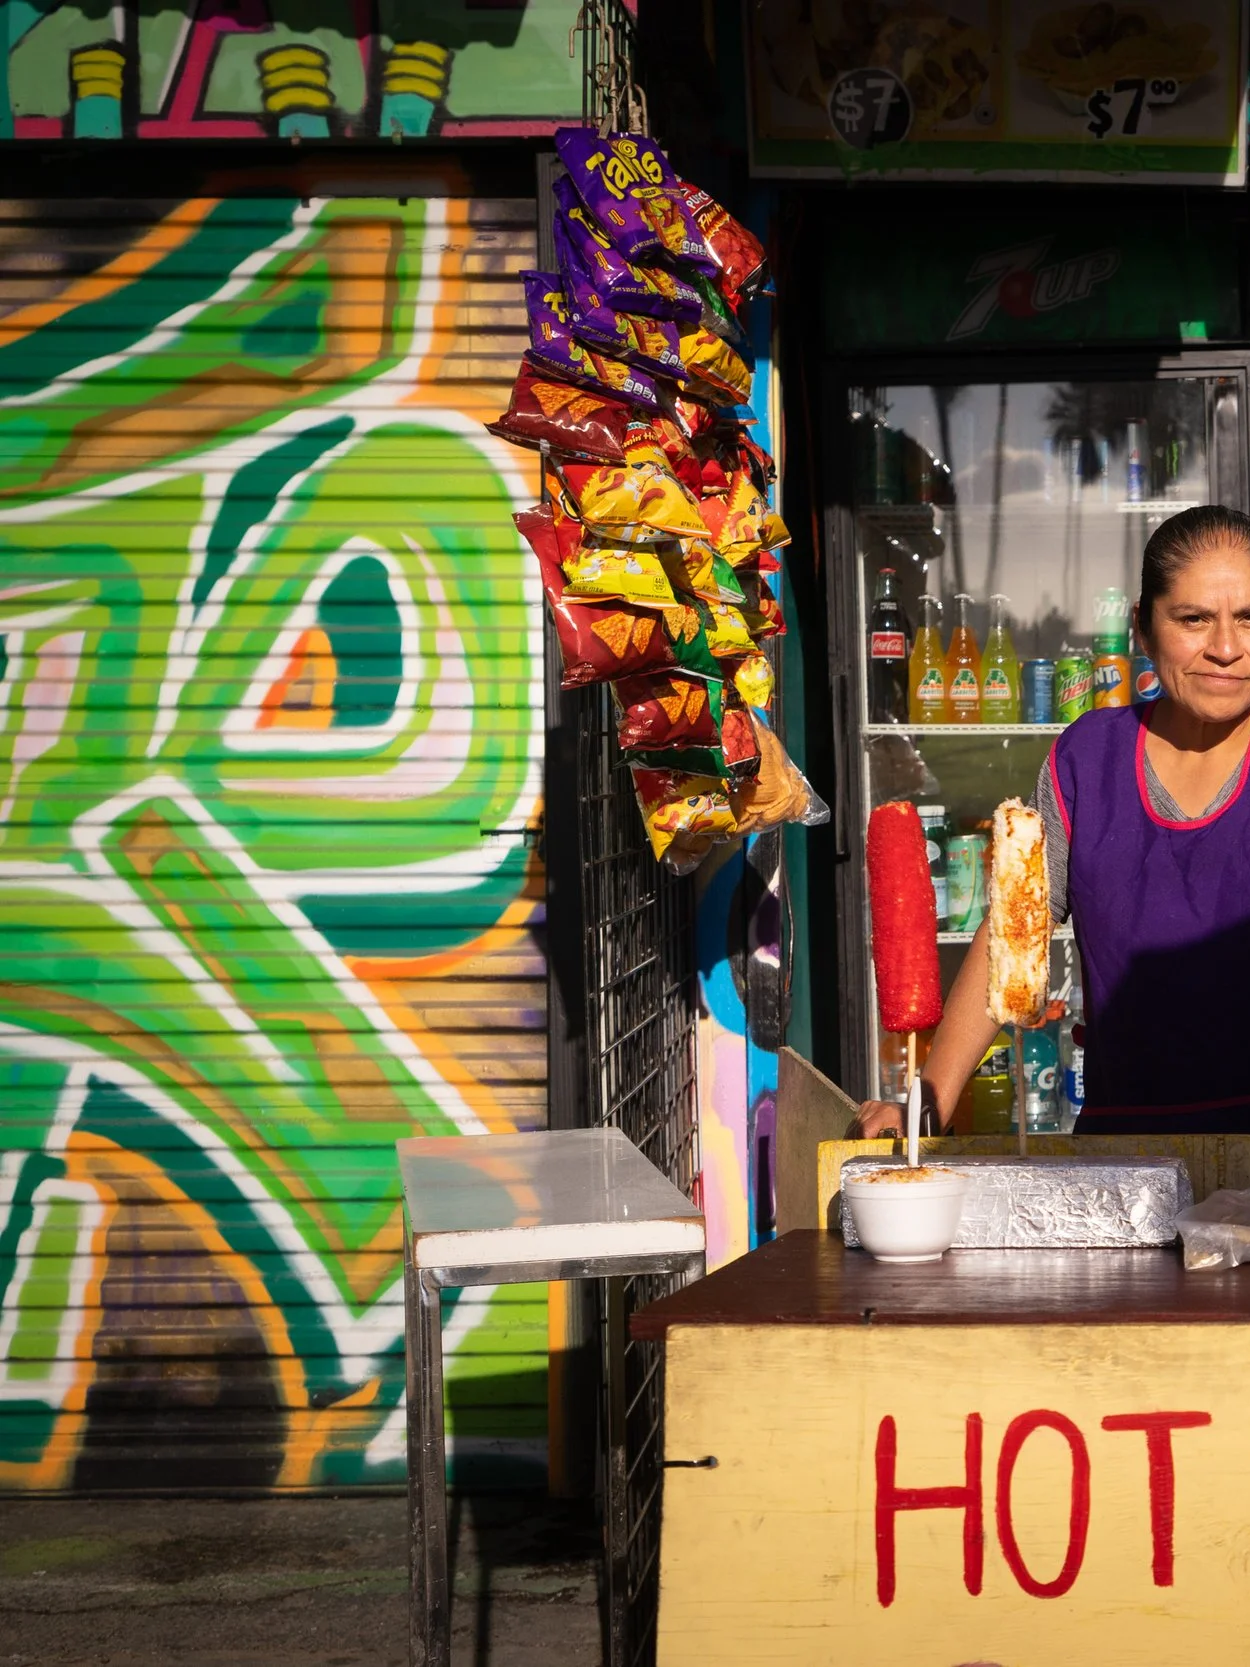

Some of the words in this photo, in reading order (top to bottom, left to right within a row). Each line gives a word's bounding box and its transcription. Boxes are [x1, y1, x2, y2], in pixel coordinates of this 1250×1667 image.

[835, 79, 900, 133] $7
[585, 139, 663, 200] Takis
[875, 1408, 1212, 1607] HOT
